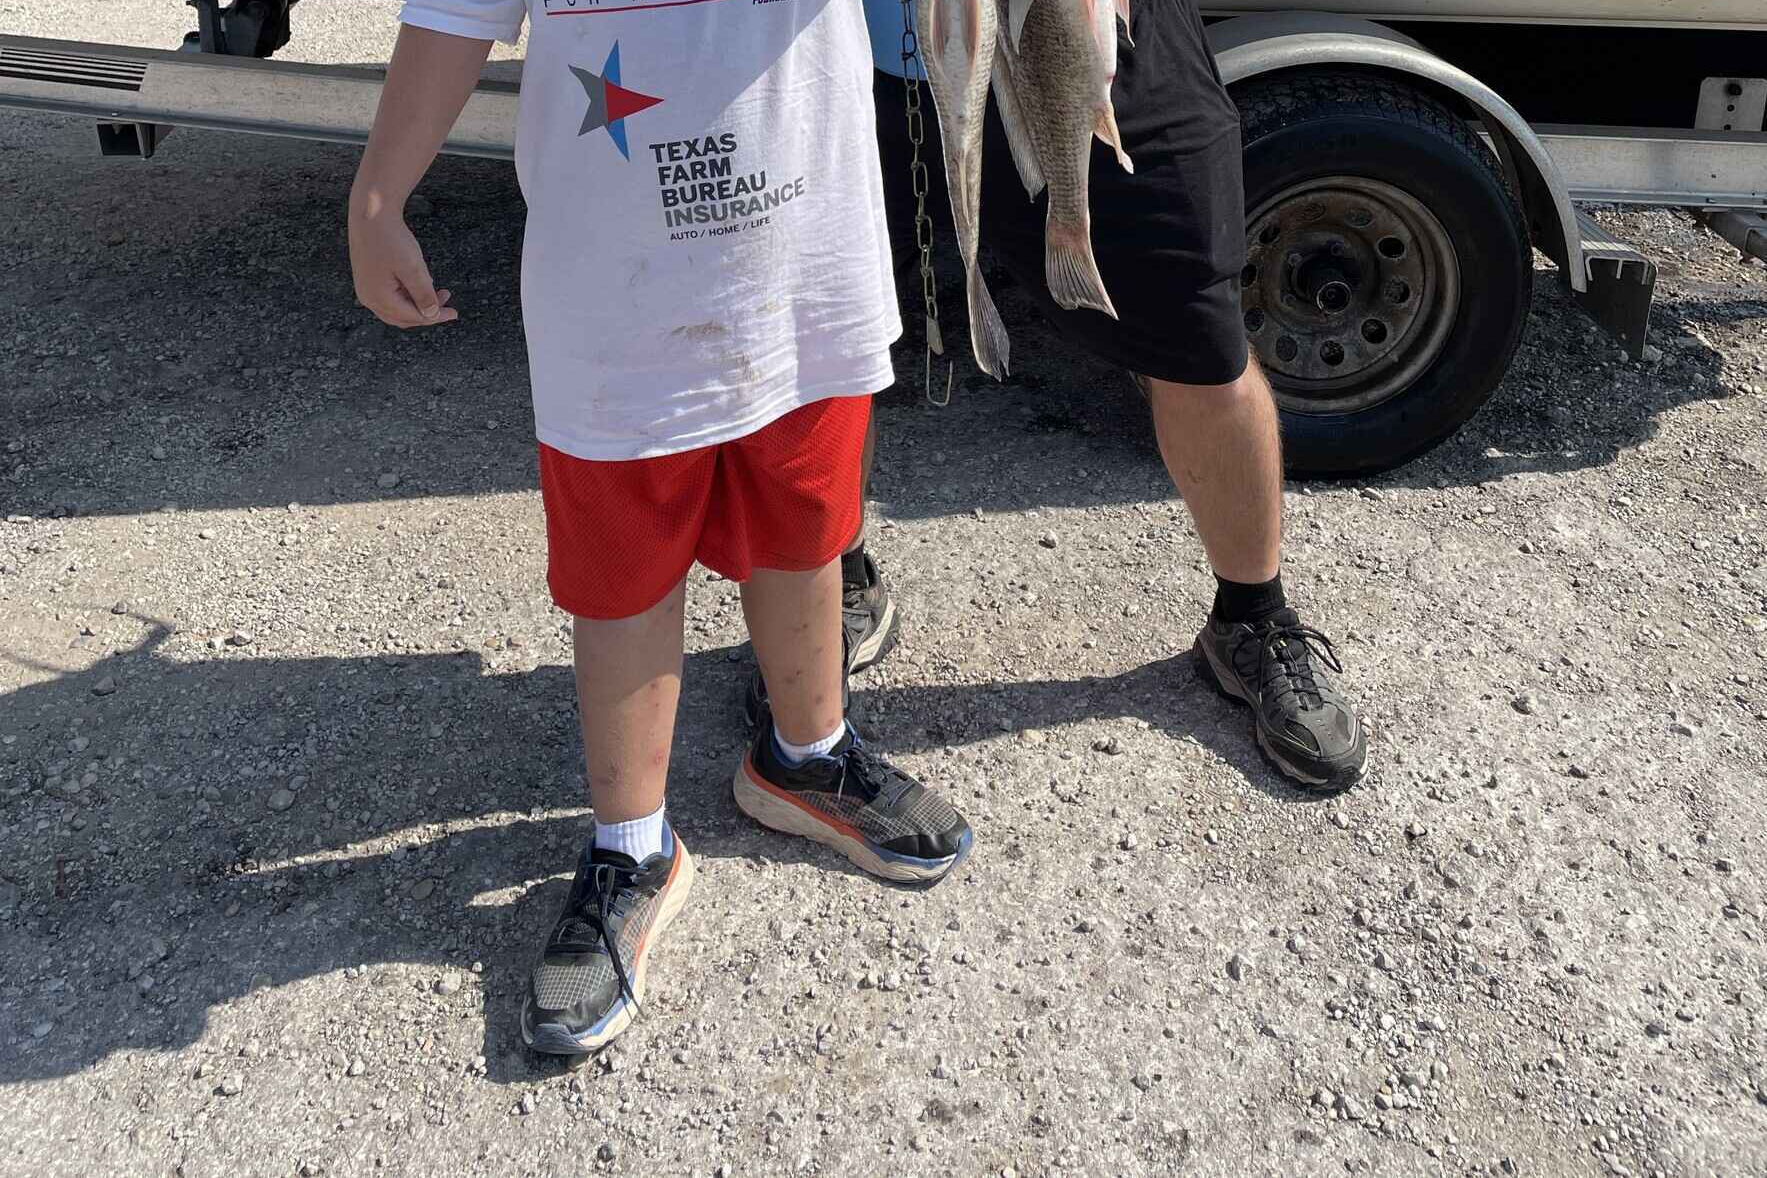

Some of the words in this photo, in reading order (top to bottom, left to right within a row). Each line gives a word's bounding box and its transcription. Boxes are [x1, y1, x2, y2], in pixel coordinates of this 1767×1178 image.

[648, 132, 738, 163] TEXAS
[657, 156, 732, 186] FARM
[661, 171, 767, 208] BUREAU
[664, 176, 806, 228] INSURANCE
[670, 230, 698, 241] AUTO
[708, 224, 740, 237] HOME
[751, 216, 771, 229] LIFE
